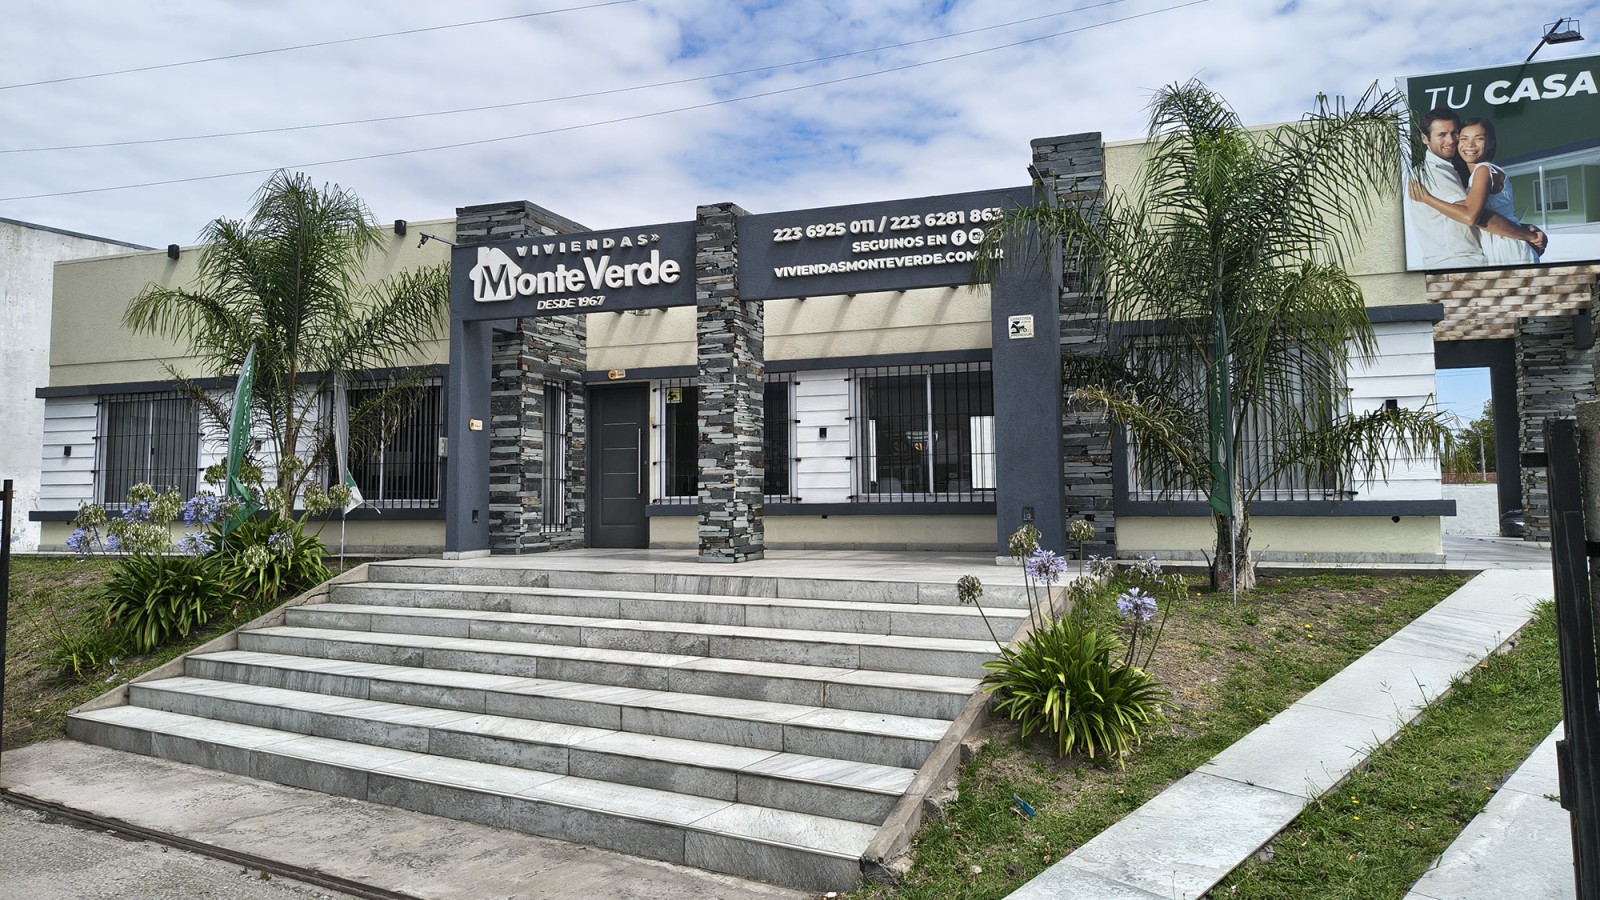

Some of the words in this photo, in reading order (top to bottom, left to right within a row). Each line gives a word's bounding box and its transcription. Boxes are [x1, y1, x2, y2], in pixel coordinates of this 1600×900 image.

[1425, 84, 1473, 111] TU
[1483, 70, 1599, 106] CASA
[772, 226, 803, 242] 223
[805, 222, 847, 239] 6925
[849, 219, 875, 234] 011
[877, 215, 888, 234] /
[889, 214, 922, 231] 223
[924, 210, 966, 227] 6281
[515, 234, 649, 257] VIVIENDAS
[851, 235, 925, 253] SEGUINOS
[926, 233, 947, 246] EN
[536, 297, 577, 311] DESDE
[577, 295, 606, 307] 1967
